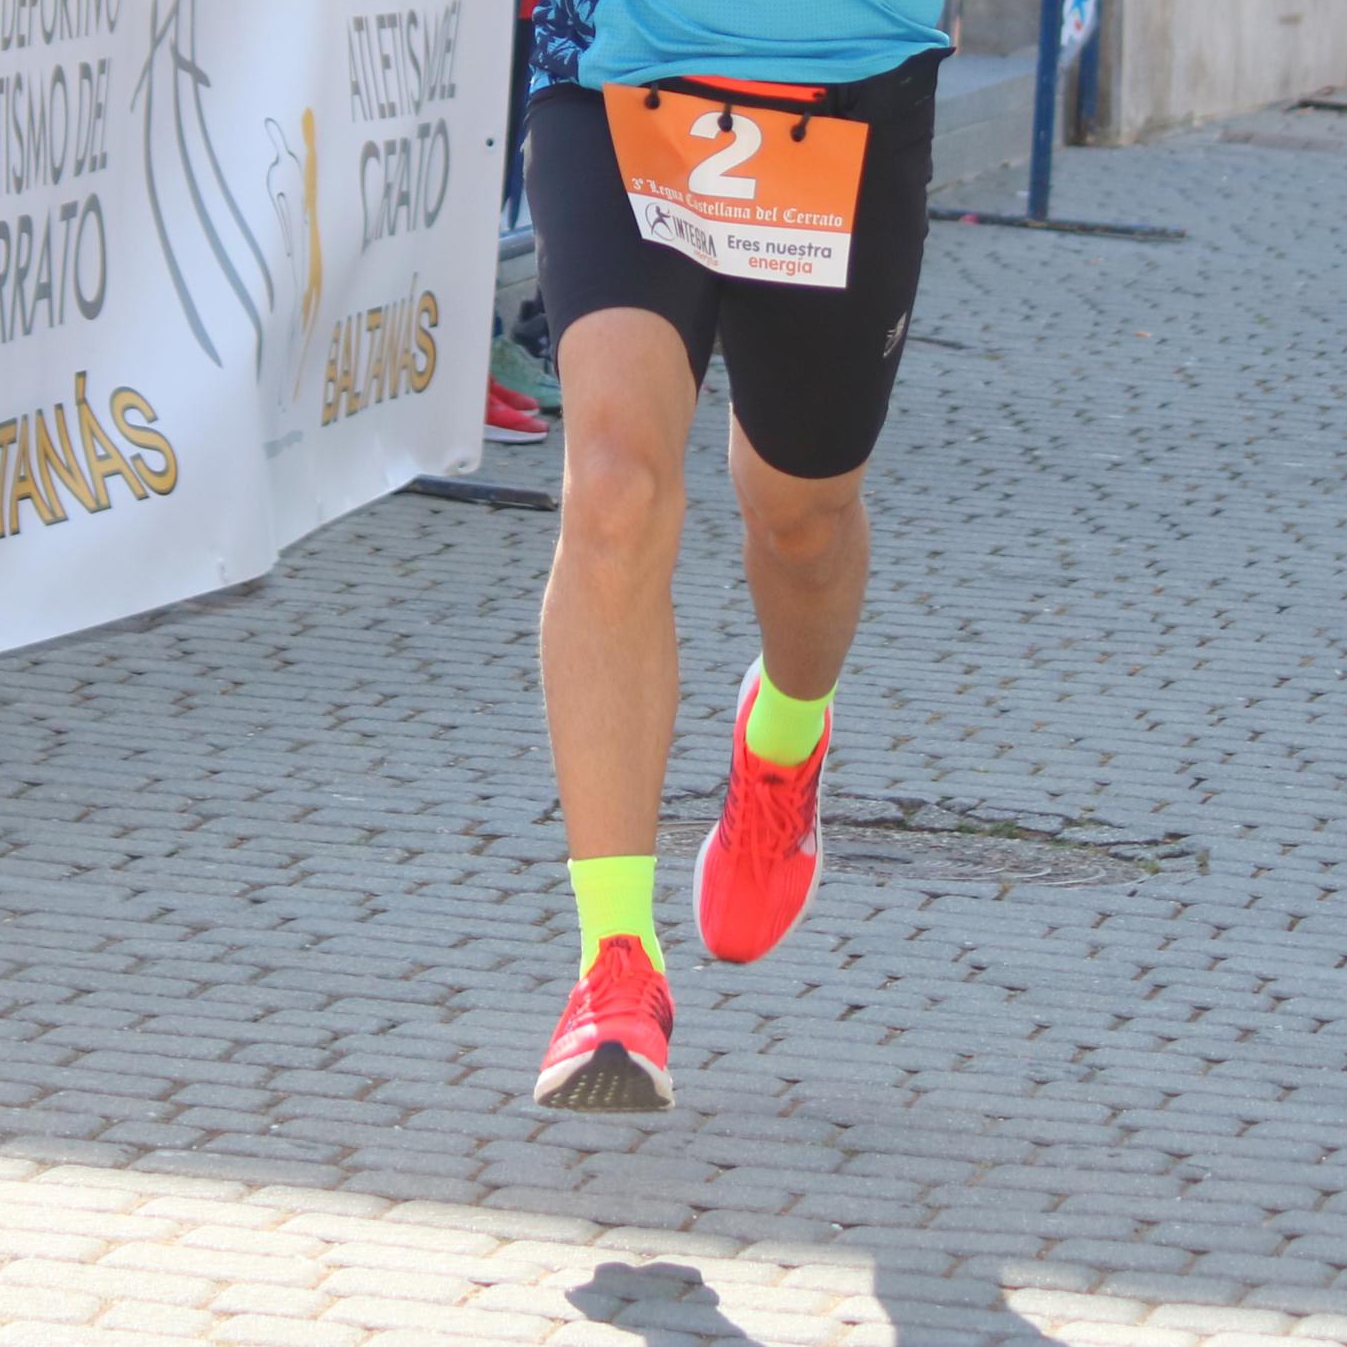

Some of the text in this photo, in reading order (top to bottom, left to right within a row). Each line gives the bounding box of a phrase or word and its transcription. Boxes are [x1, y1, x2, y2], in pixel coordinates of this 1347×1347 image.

[74, 57, 112, 178] DEL
[687, 111, 762, 200] 2
[647, 179, 685, 202] Legua
[686, 194, 751, 220] Castellana
[756, 205, 778, 222] del
[782, 207, 844, 228] Cerrato
[672, 215, 717, 258] INTEGRA
[727, 234, 833, 260] Eres nuestra
[748, 255, 813, 277] energía
